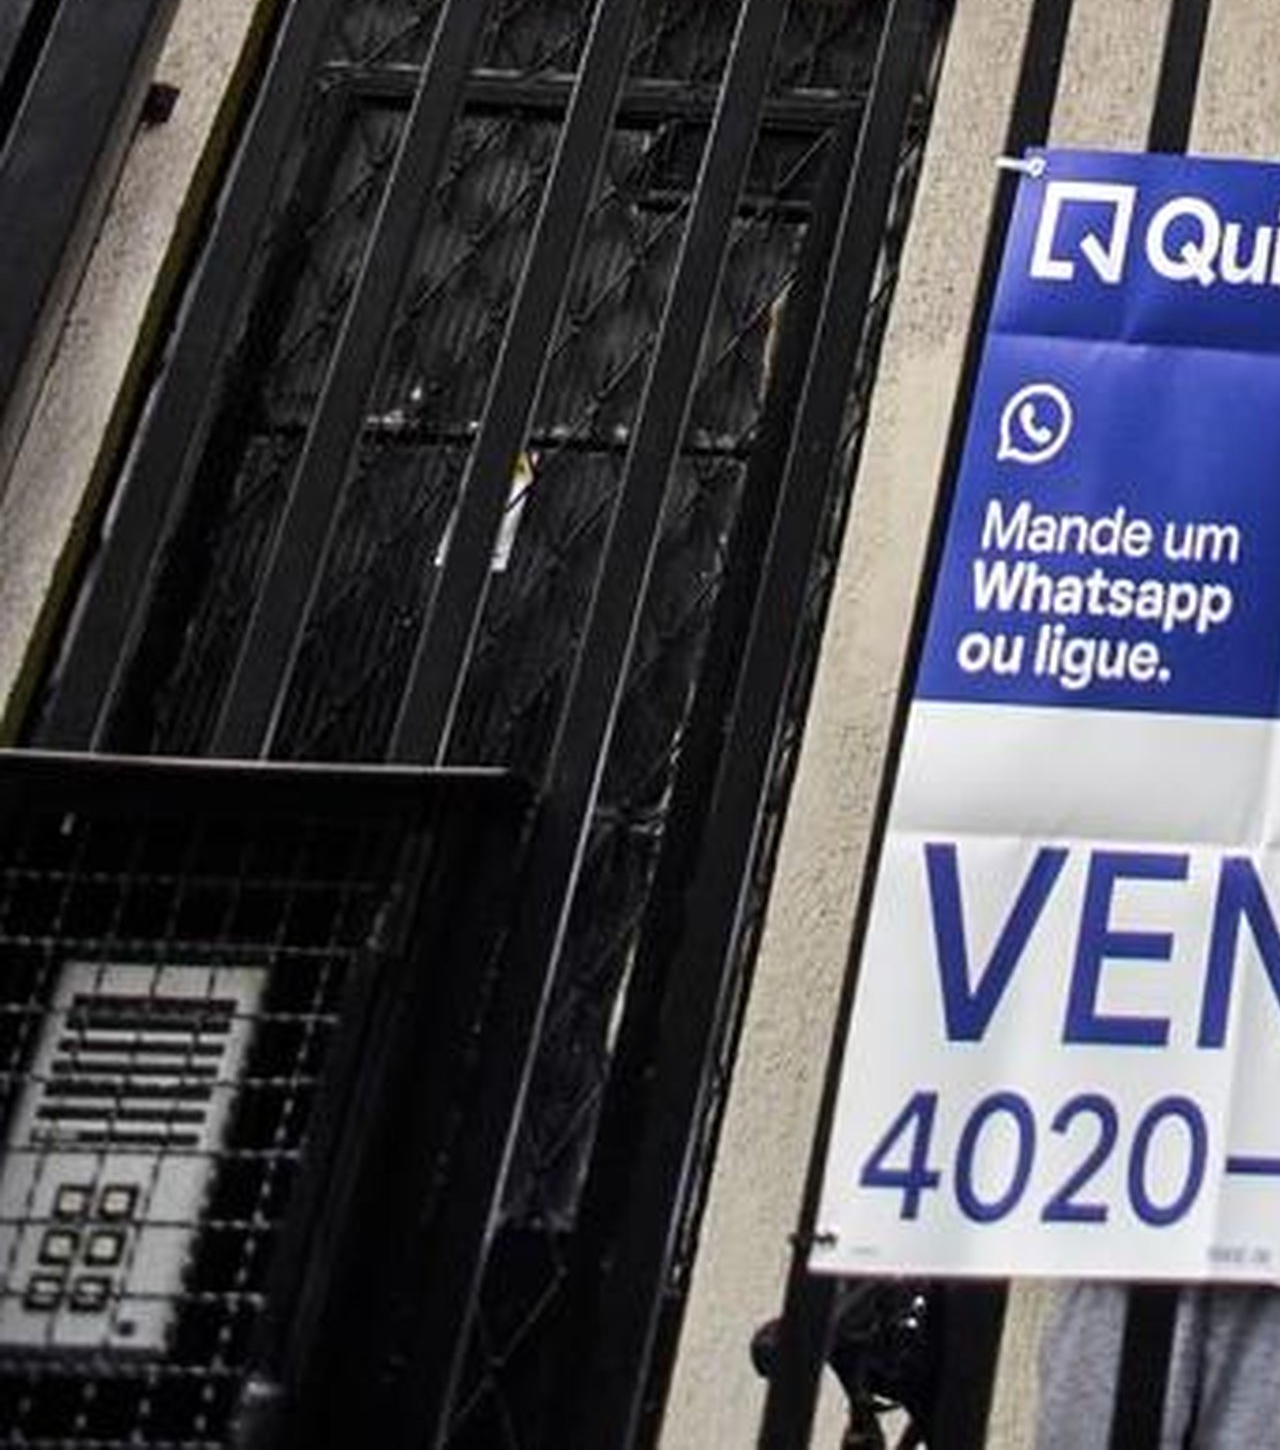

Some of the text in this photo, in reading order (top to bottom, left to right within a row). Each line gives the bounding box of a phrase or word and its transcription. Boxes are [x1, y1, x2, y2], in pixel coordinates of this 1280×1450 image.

[981, 498, 1241, 563] Mande um
[972, 558, 1234, 634] Whatsapp
[956, 623, 1172, 690] ou ligue.
